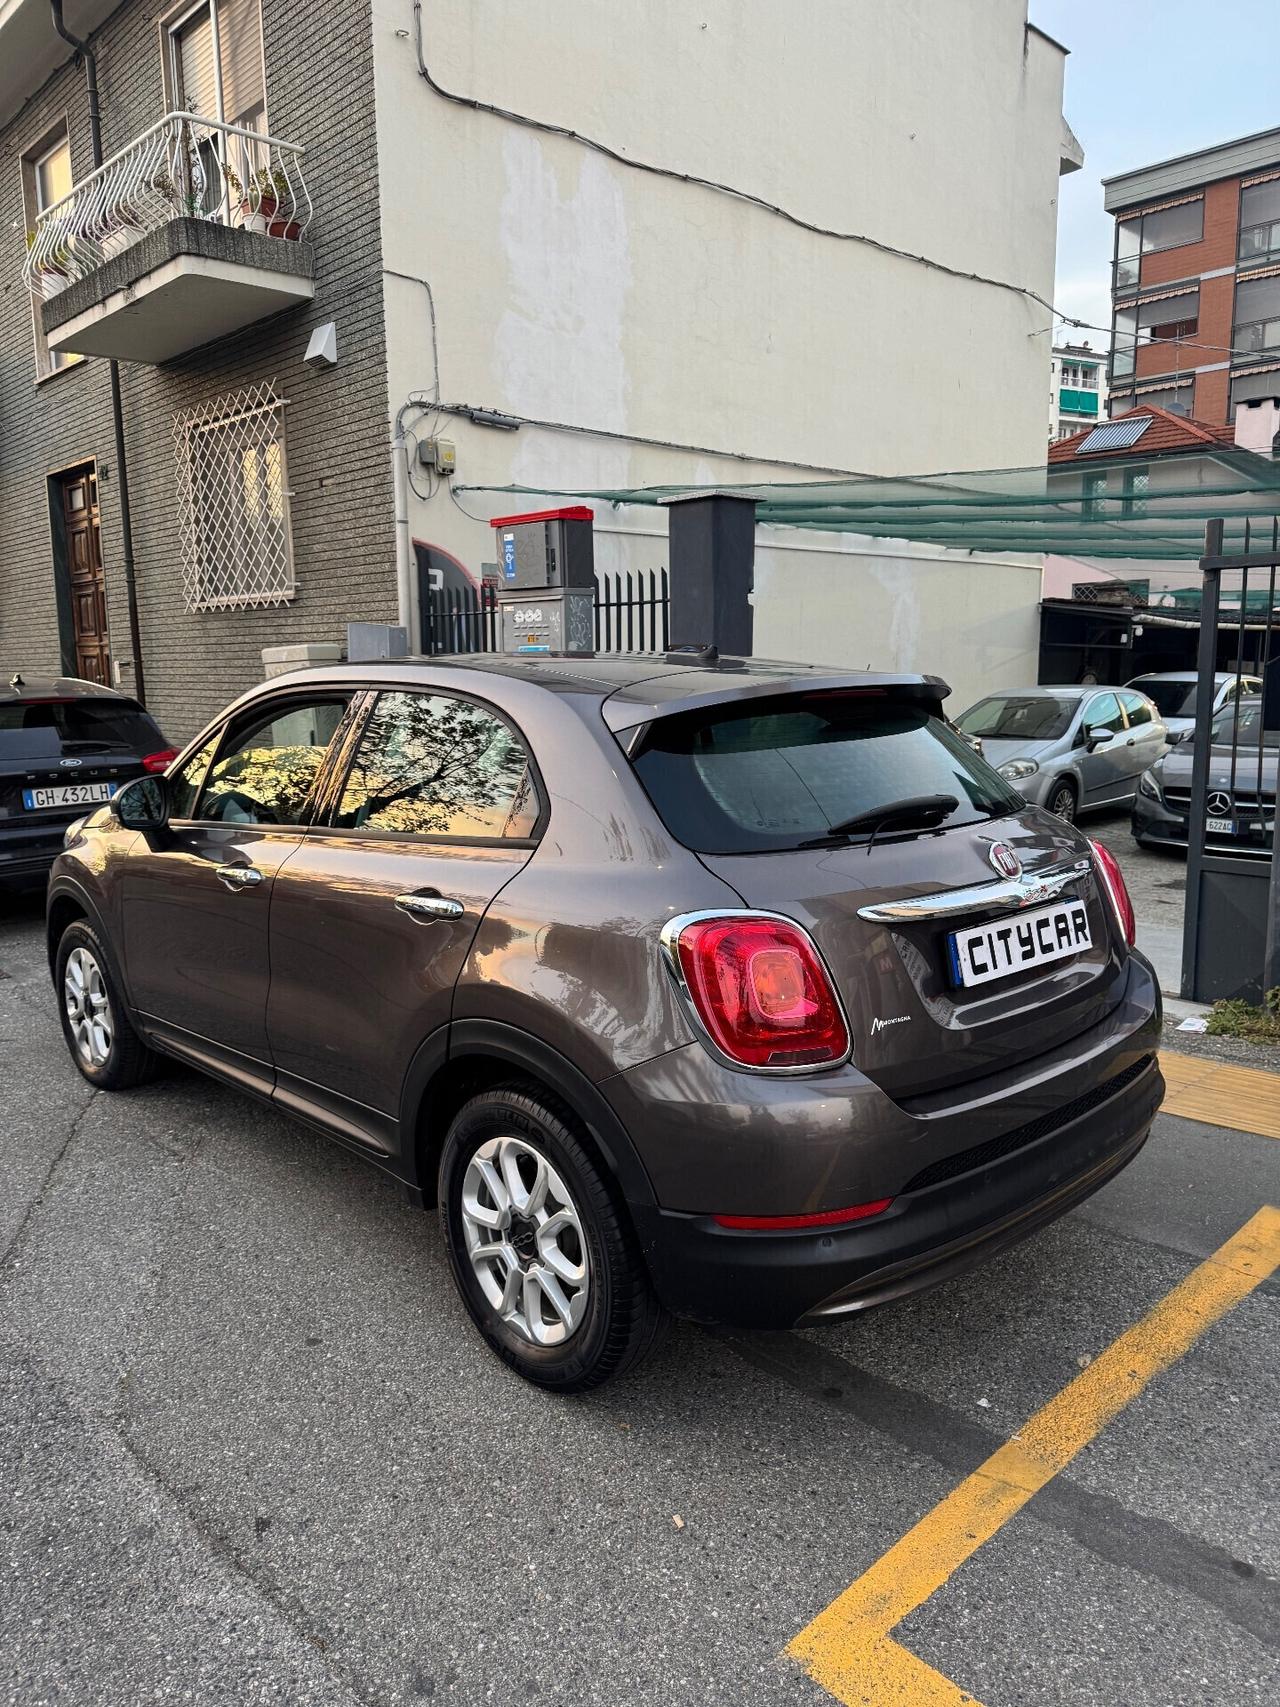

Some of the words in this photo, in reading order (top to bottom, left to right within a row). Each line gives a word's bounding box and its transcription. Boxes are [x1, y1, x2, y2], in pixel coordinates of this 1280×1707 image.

[27, 769, 118, 779] FOCUS
[35, 790, 55, 806] GH
[62, 785, 109, 804] 432LH
[967, 908, 1089, 976] CITYCAR
